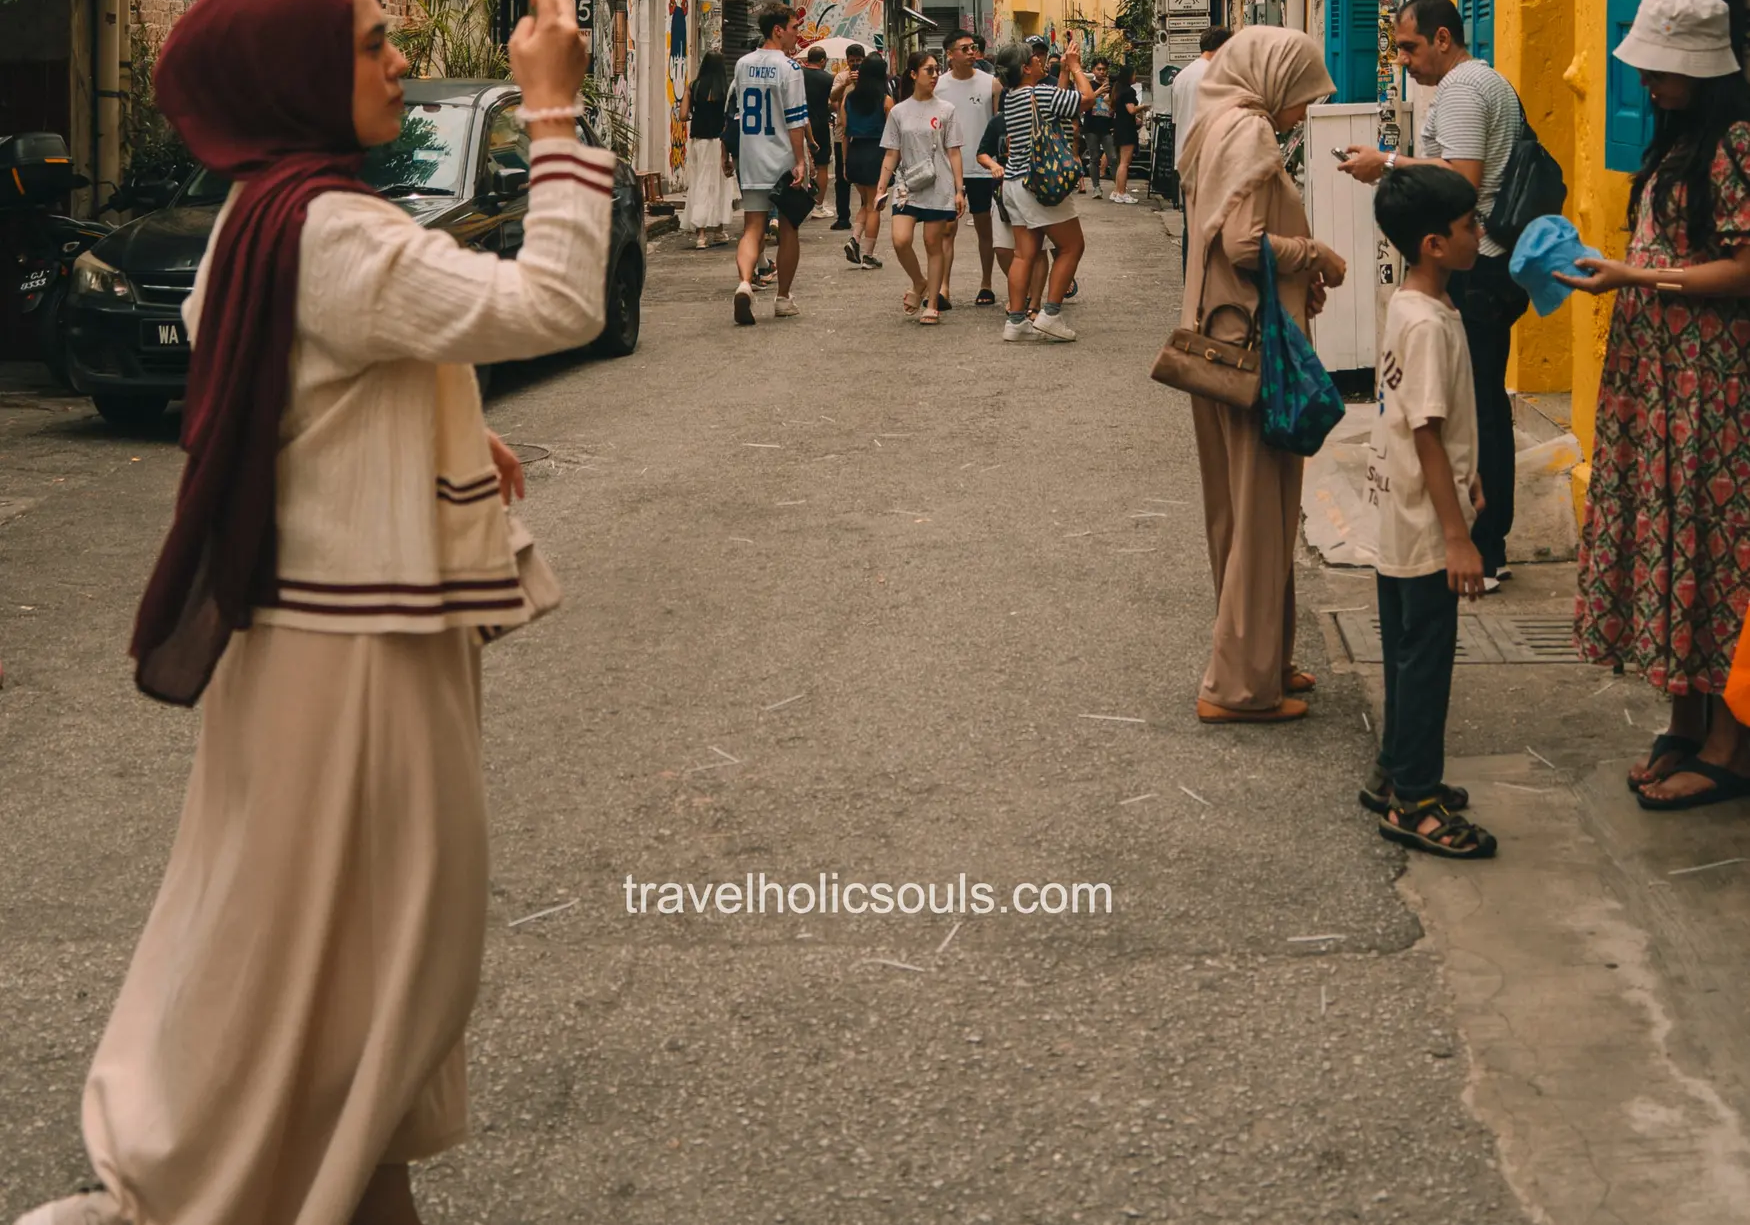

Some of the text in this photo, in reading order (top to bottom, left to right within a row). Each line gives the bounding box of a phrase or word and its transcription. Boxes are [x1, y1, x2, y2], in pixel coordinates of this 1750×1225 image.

[749, 65, 776, 79] OWENS
[742, 87, 775, 135] 81
[158, 325, 179, 344] WA
